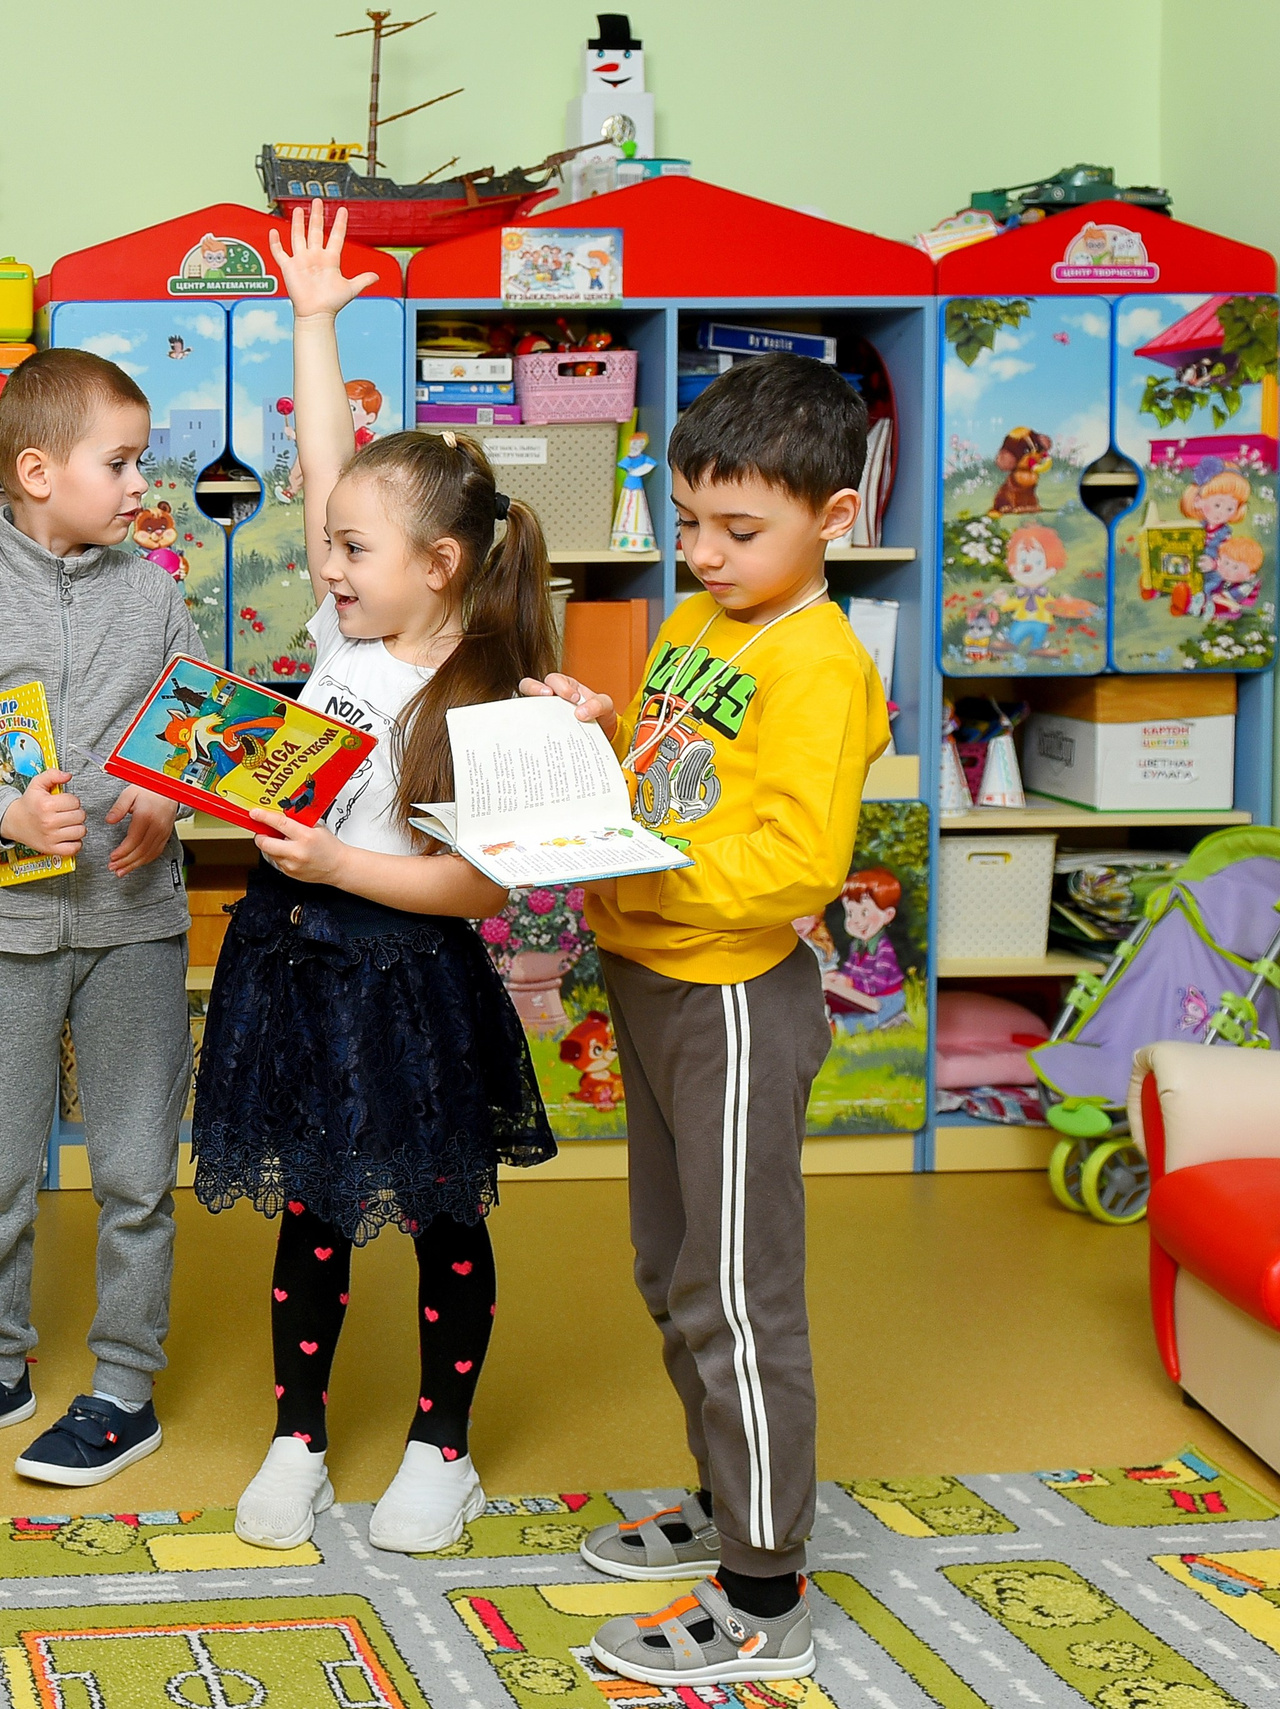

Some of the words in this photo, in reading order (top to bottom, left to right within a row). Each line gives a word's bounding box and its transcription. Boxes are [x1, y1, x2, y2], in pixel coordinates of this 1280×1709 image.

[1063, 268, 1092, 278] ЦЕНТР
[1094, 268, 1149, 277] ТВОРЧЕСТВА
[176, 282, 205, 291] ЦЕНТР
[207, 281, 269, 290] МАТЕМАТИКИ
[1143, 727, 1190, 735] КАРТОН
[252, 740, 302, 785] ЛИСА
[265, 727, 340, 797] ЛАПОТОЧКОМ
